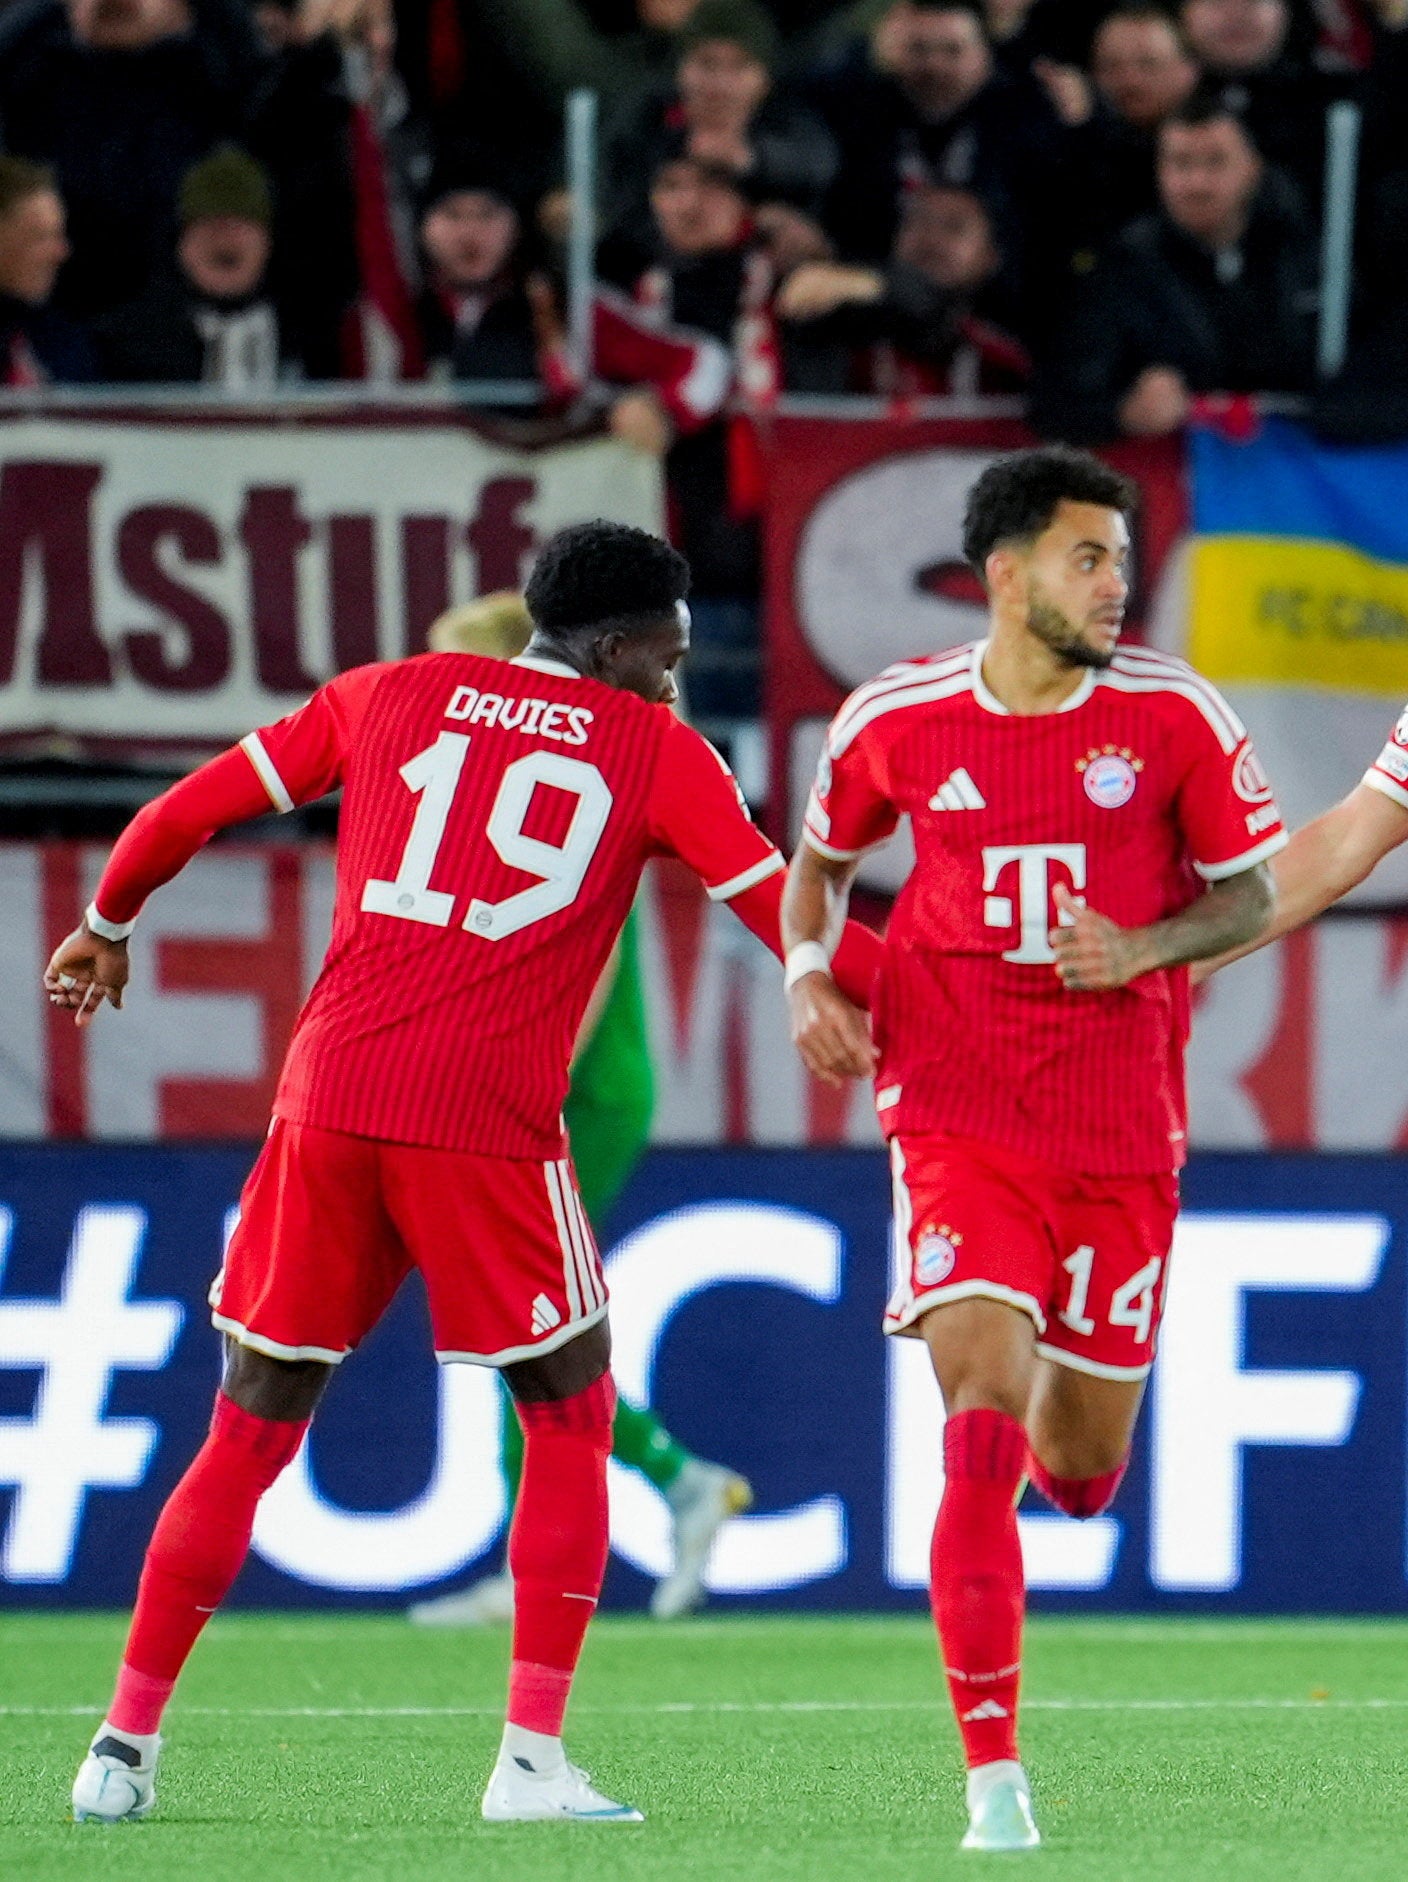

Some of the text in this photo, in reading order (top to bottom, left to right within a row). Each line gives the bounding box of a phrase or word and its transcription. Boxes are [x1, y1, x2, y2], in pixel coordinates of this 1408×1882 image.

[445, 685, 594, 745] DAVIES
[361, 730, 613, 942] 19
[982, 843, 1086, 964] T
[1063, 1246, 1163, 1344] 14
